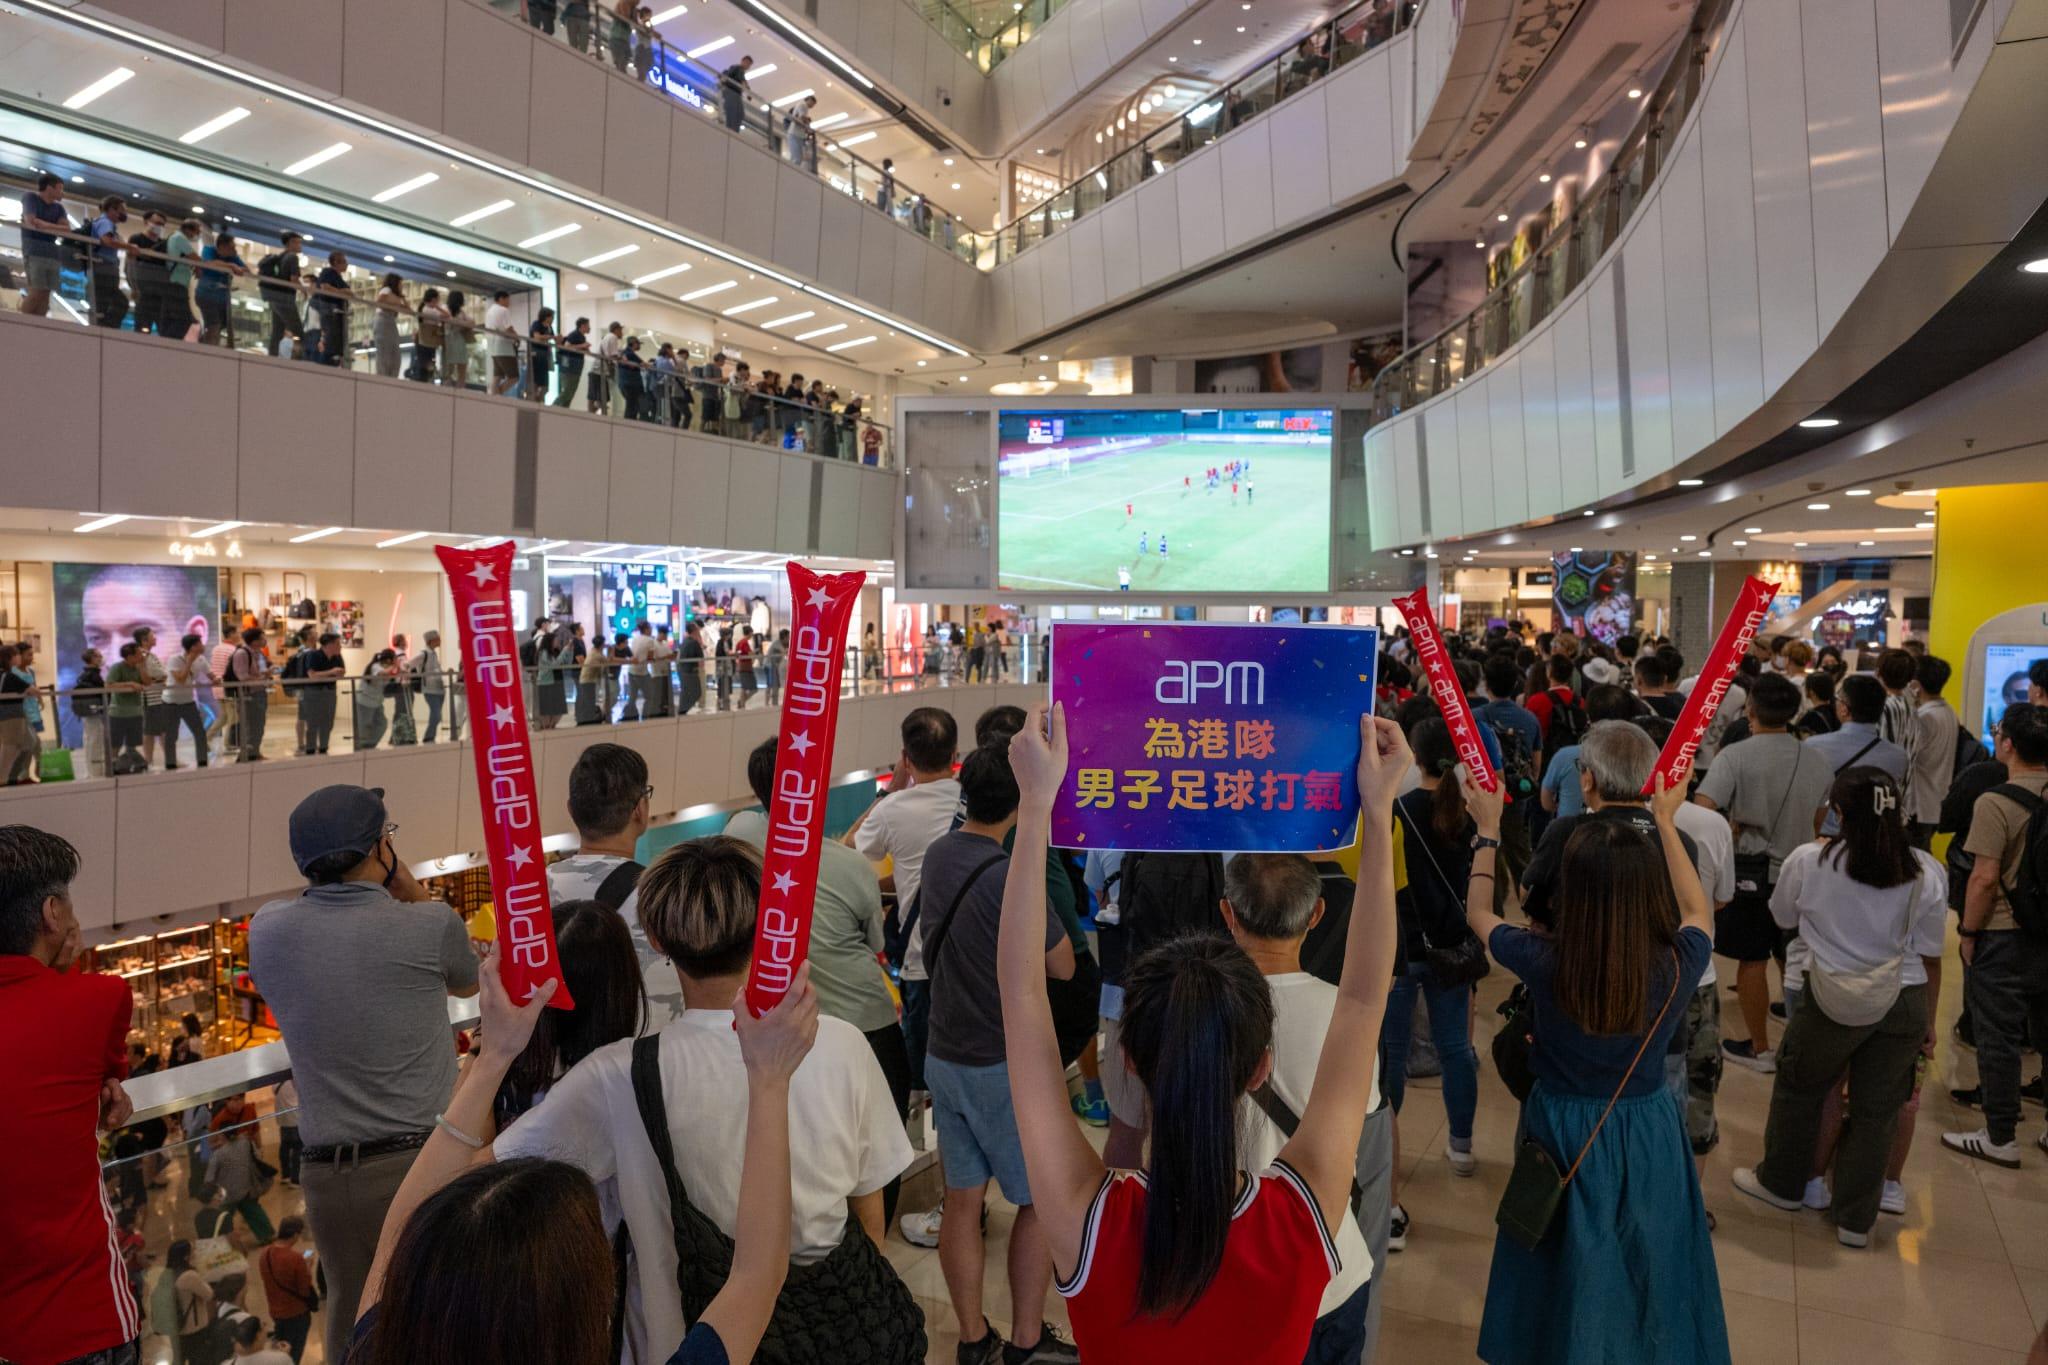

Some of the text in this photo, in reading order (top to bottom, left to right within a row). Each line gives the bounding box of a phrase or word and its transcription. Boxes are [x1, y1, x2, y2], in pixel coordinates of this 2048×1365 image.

[1143, 717, 1276, 760] 為港隊
[1155, 660, 1265, 705] apm
[1409, 615, 1490, 783] apm apm apm
[1668, 610, 1765, 782] apm apm apm
[467, 600, 549, 968] apm apm apm
[755, 626, 833, 993] apm apm apm
[1074, 768, 1344, 812] 男子足球打氣
